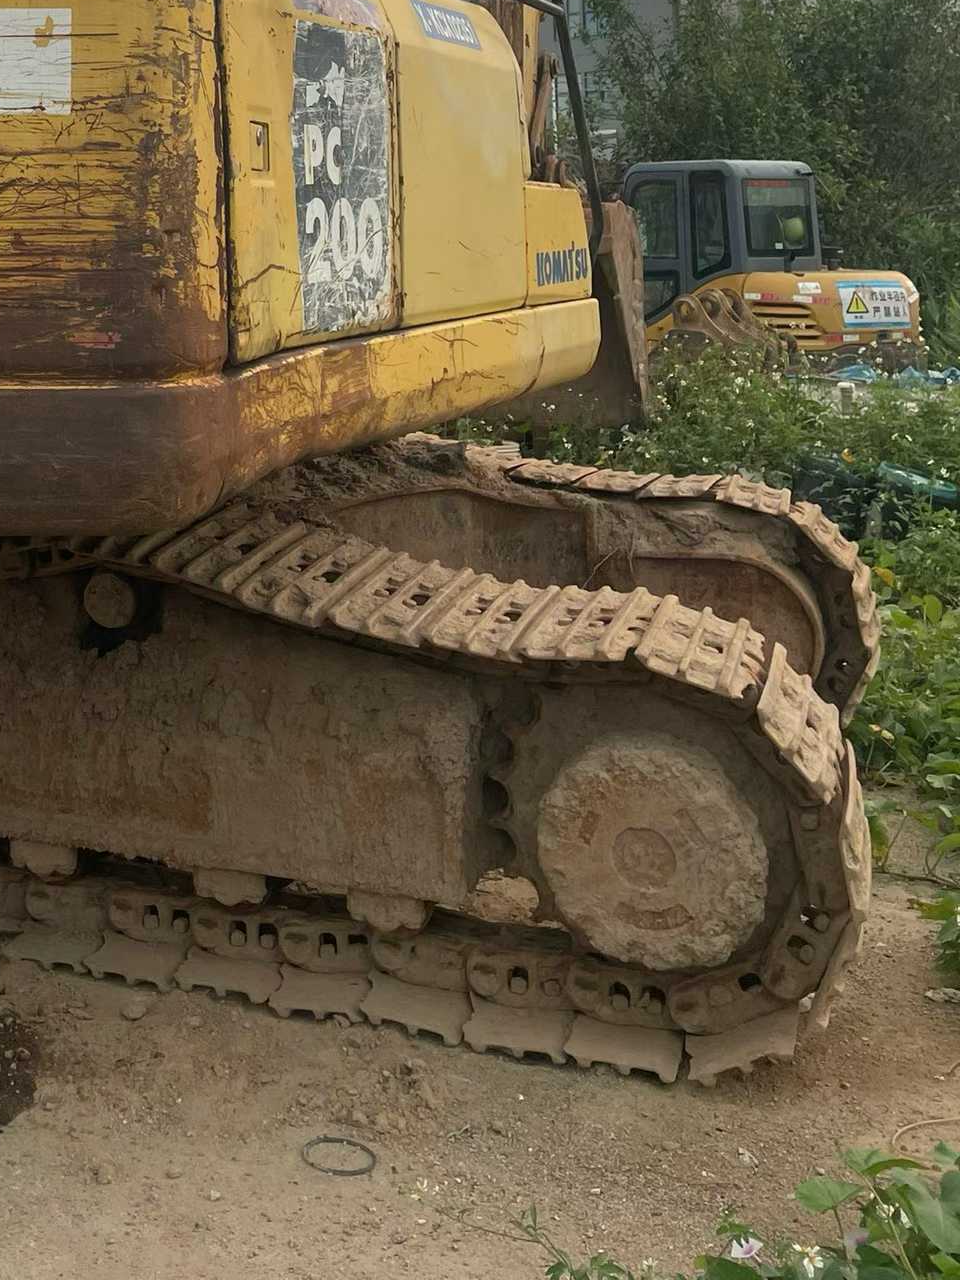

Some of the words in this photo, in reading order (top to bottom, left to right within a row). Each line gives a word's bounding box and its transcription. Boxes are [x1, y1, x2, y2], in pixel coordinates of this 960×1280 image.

[303, 124, 342, 185] PC
[305, 197, 383, 284] 200
[536, 240, 588, 287] KOMATSU
